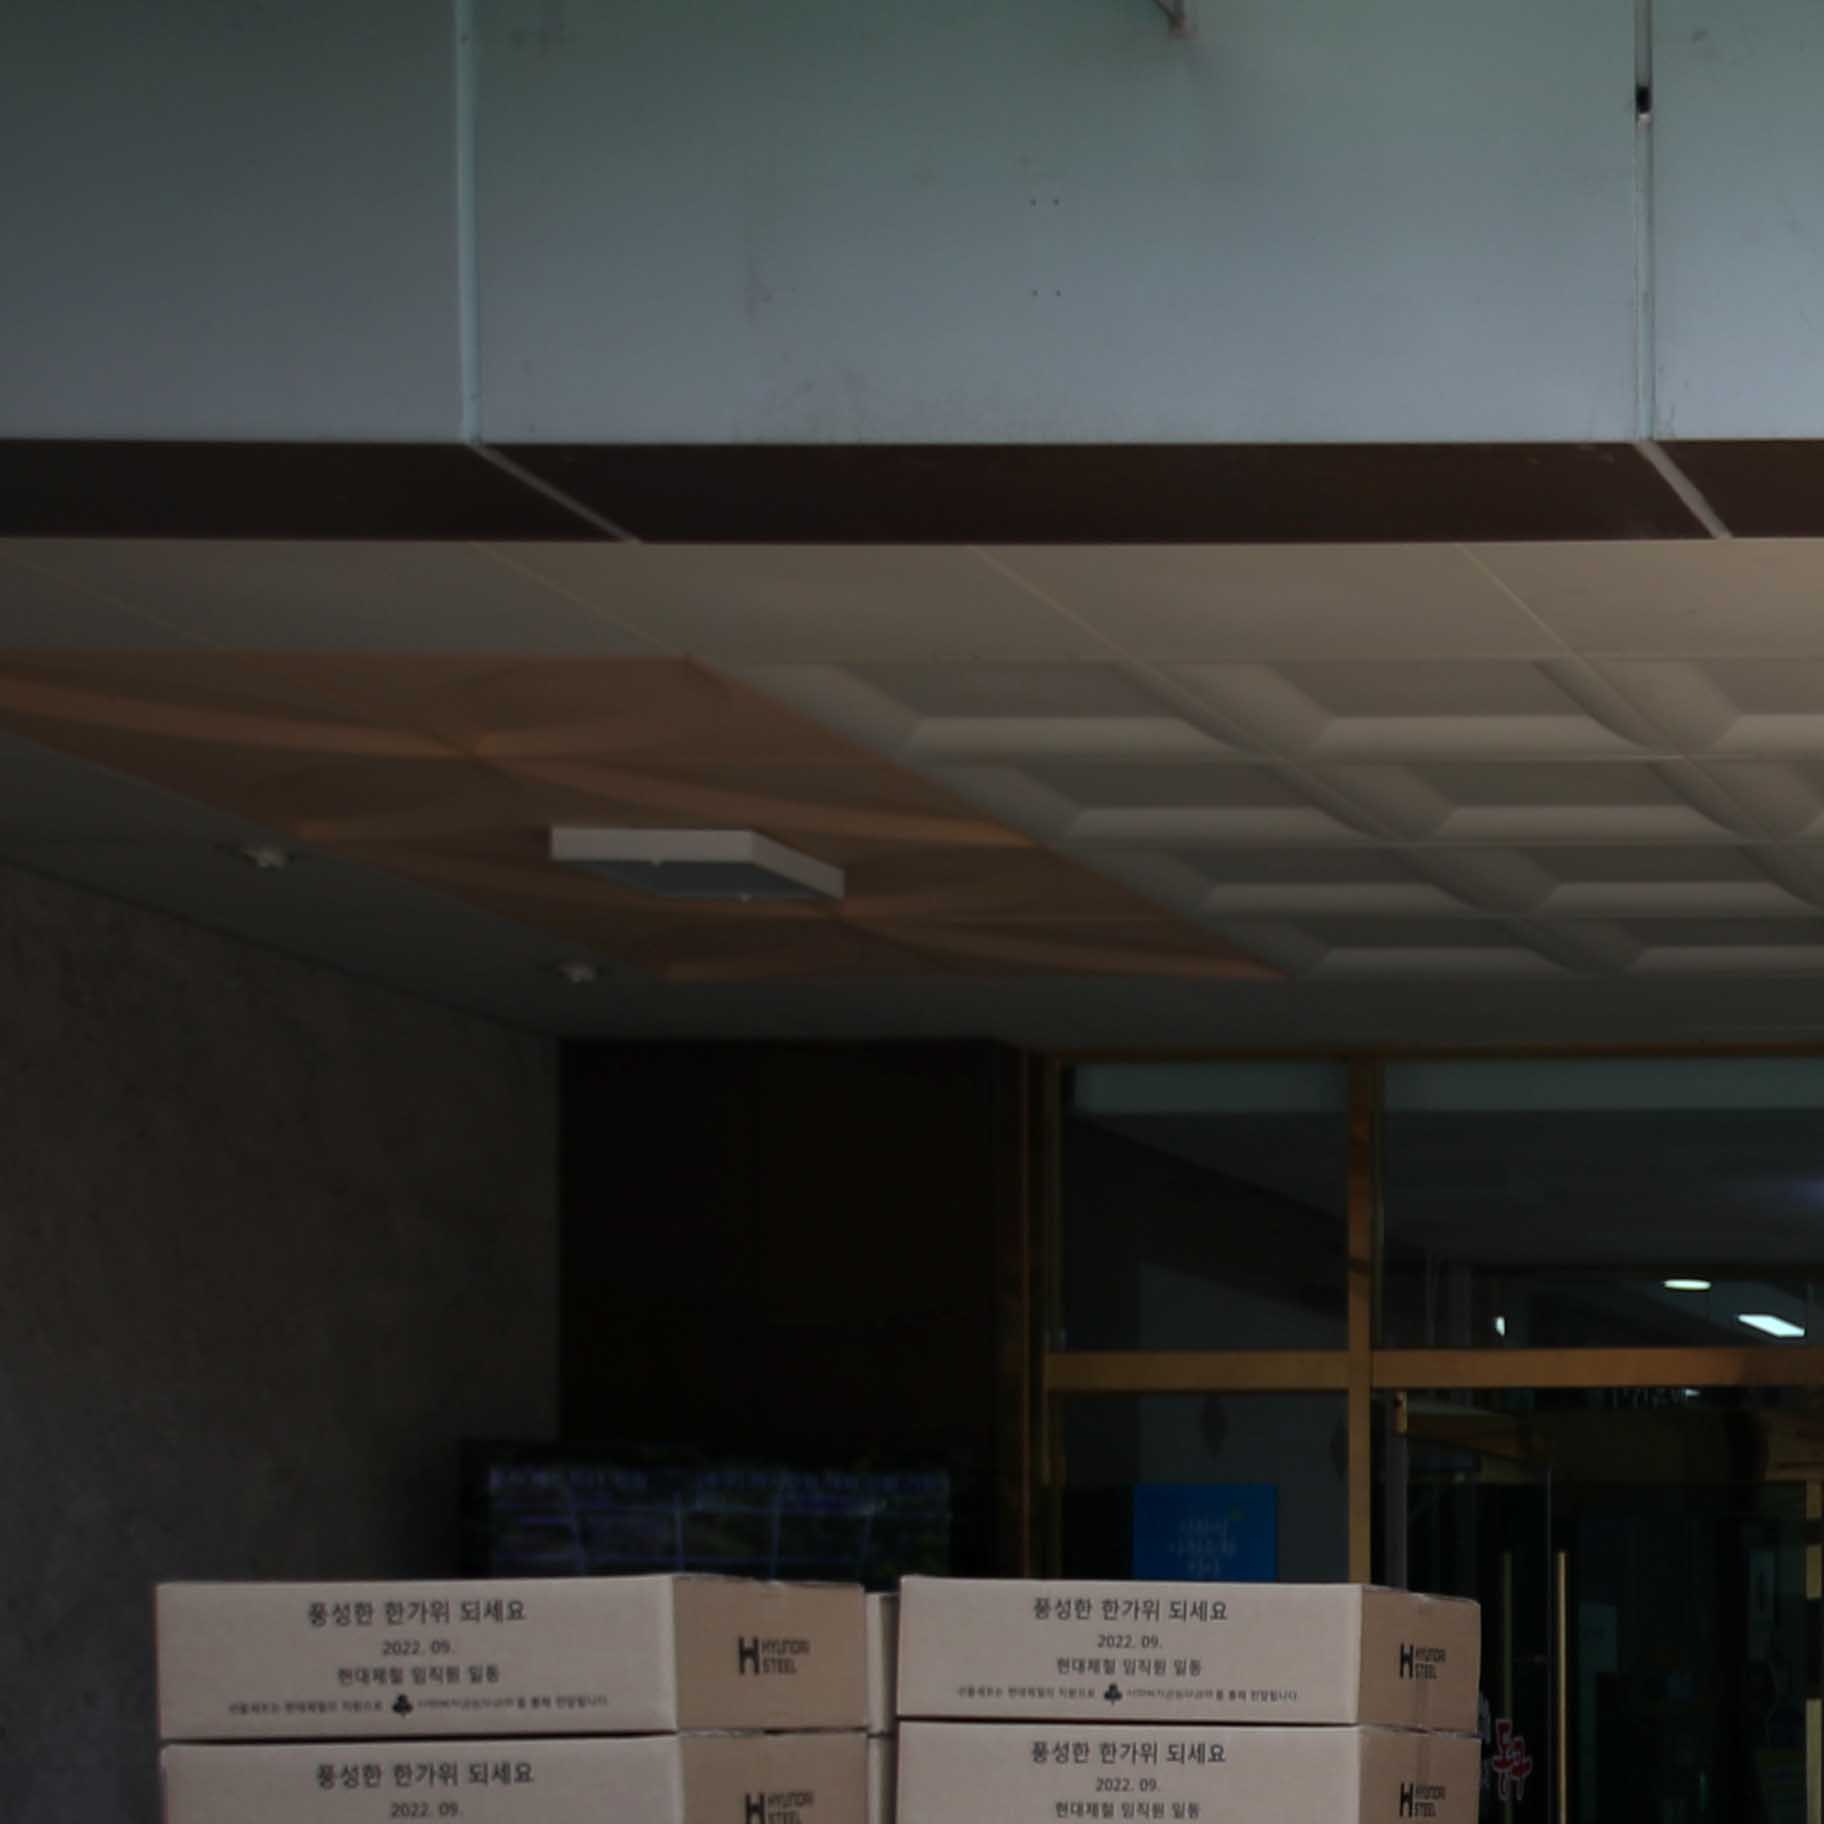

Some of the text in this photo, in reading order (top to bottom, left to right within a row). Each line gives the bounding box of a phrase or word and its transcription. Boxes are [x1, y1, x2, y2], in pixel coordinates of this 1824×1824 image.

[308, 1598, 526, 1628] 풍성한 한가위 되세요
[1033, 1597, 1227, 1622] 풍성한 한가위 되세요
[1097, 1632, 1162, 1649] 2022. 09.
[1057, 1657, 1202, 1677] 현대제철 임직원 일동
